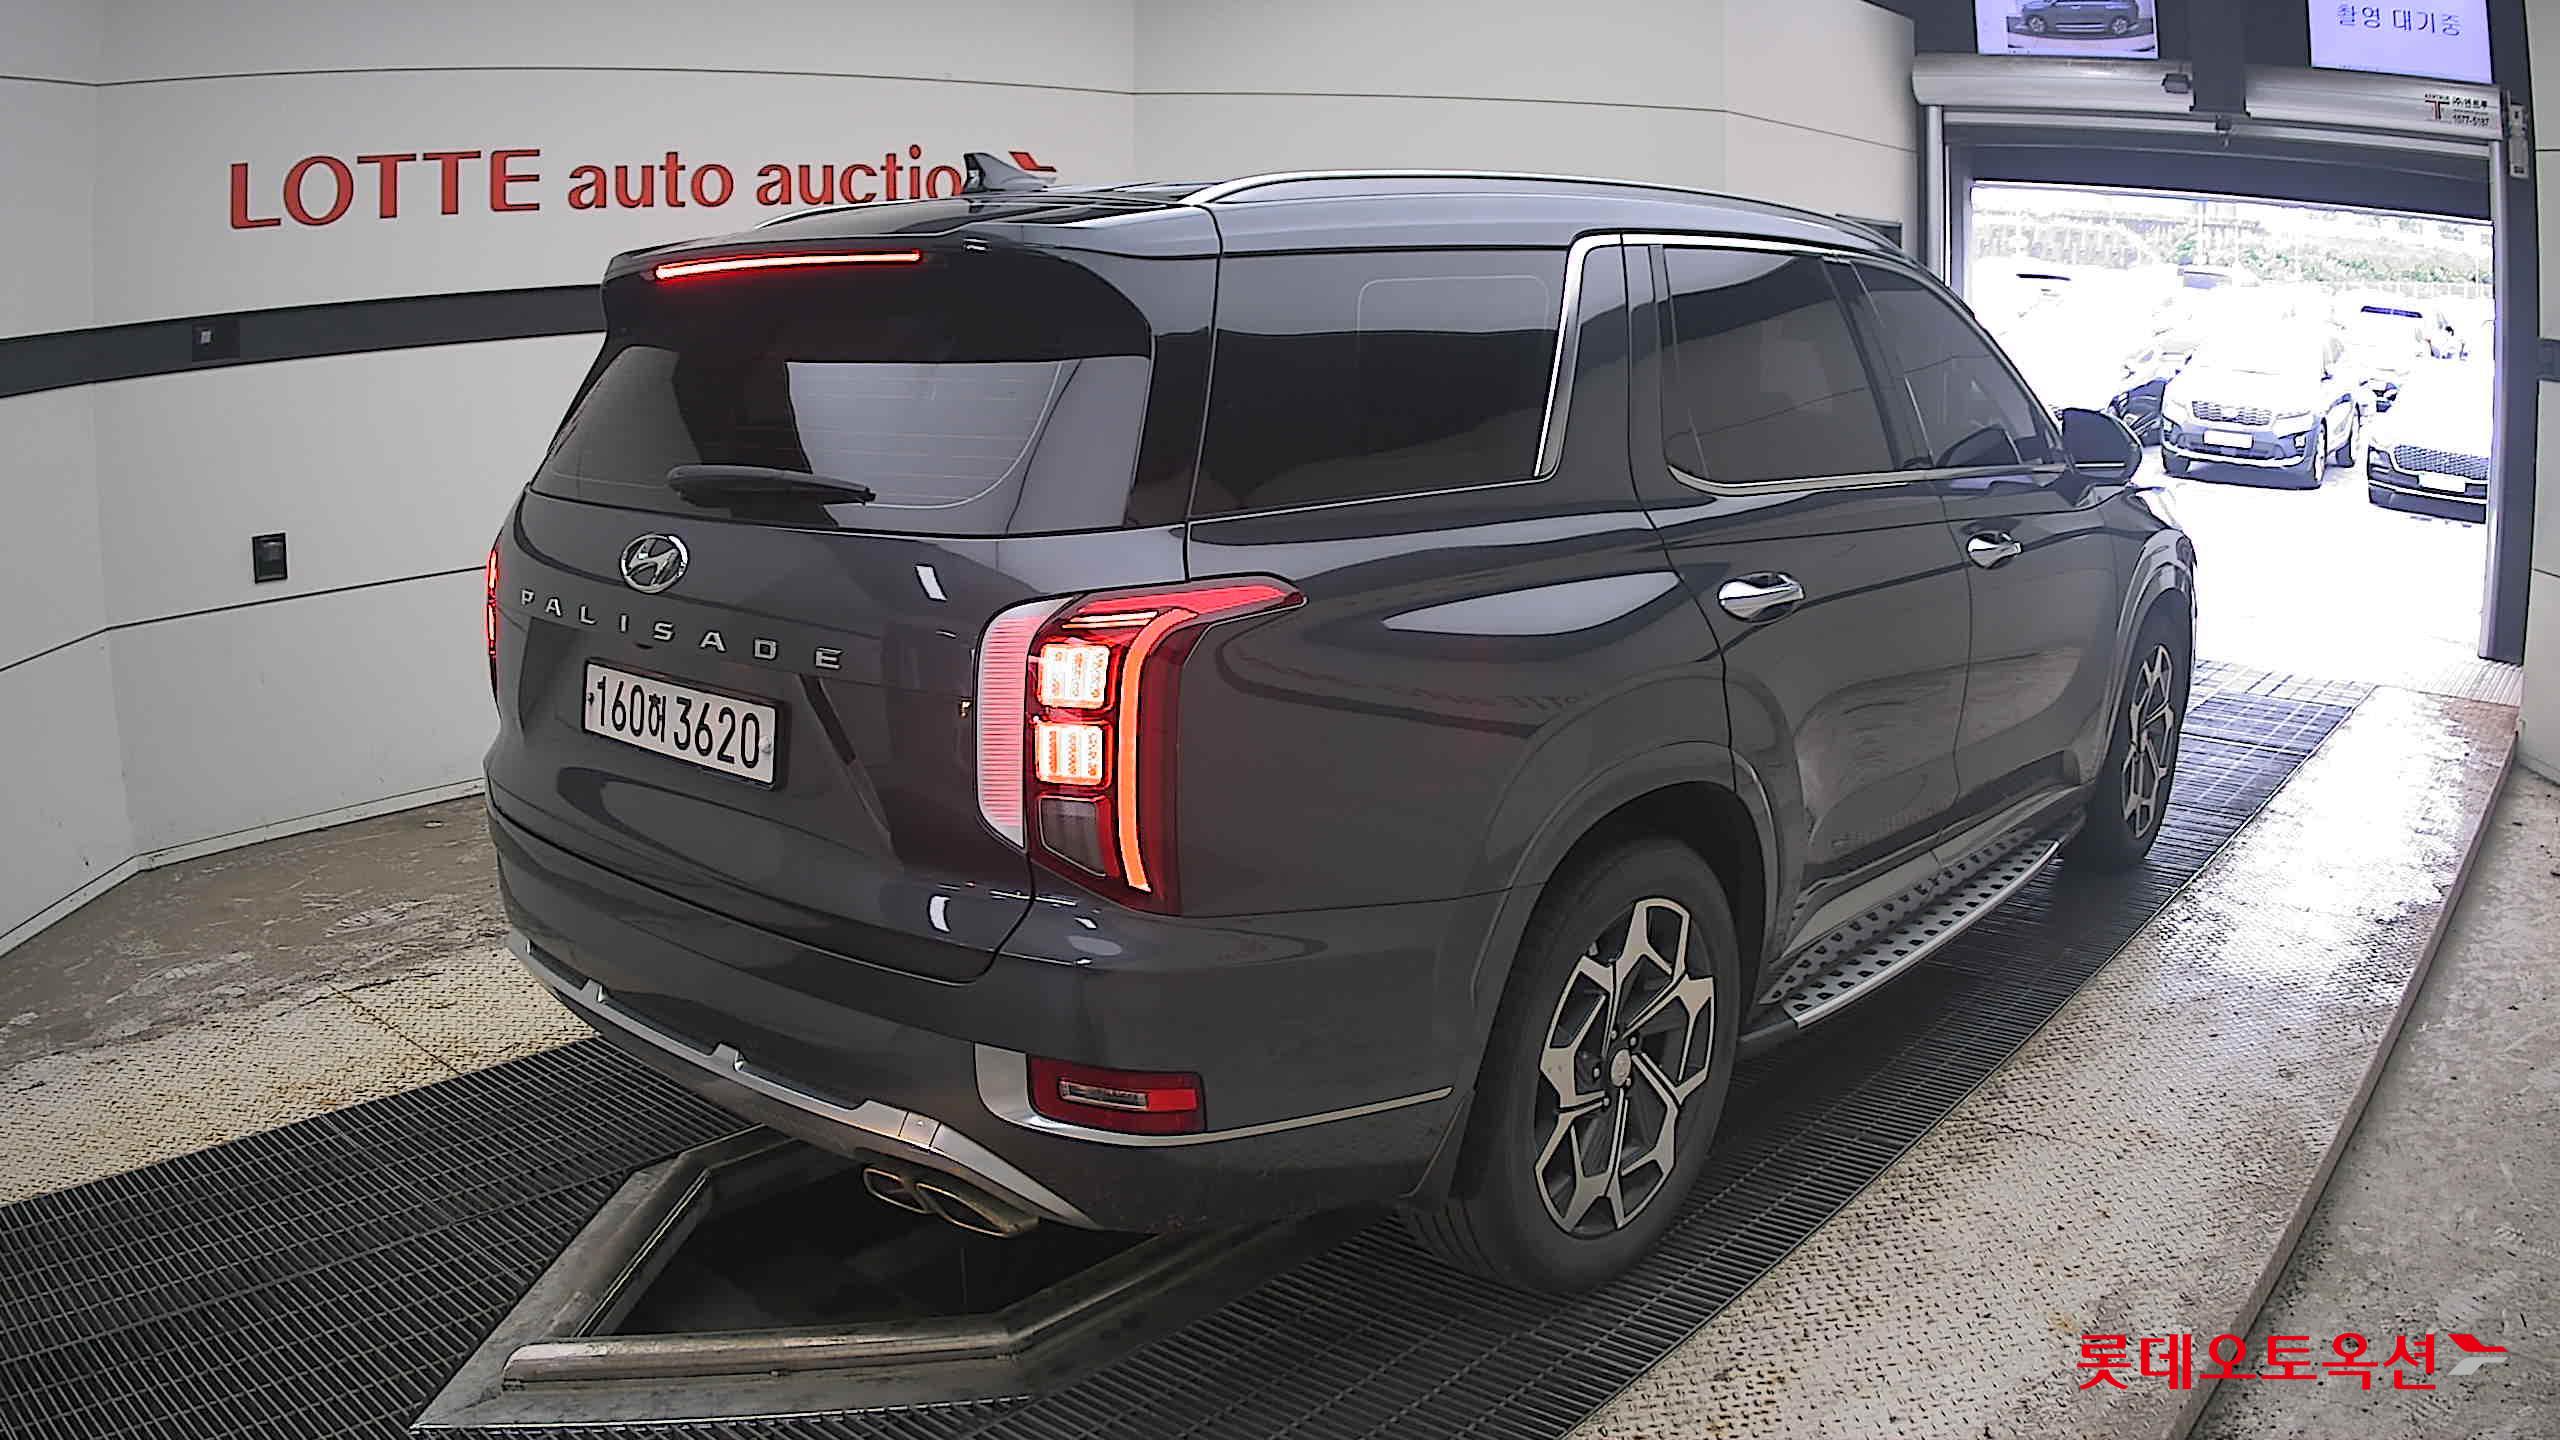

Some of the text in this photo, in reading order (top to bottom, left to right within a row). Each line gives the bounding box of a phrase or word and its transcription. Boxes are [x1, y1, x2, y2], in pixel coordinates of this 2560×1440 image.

[2338, 4, 2460, 36] 촬영 대기중
[229, 144, 963, 230] LOTTE auto auction
[520, 588, 844, 671] PALISADE
